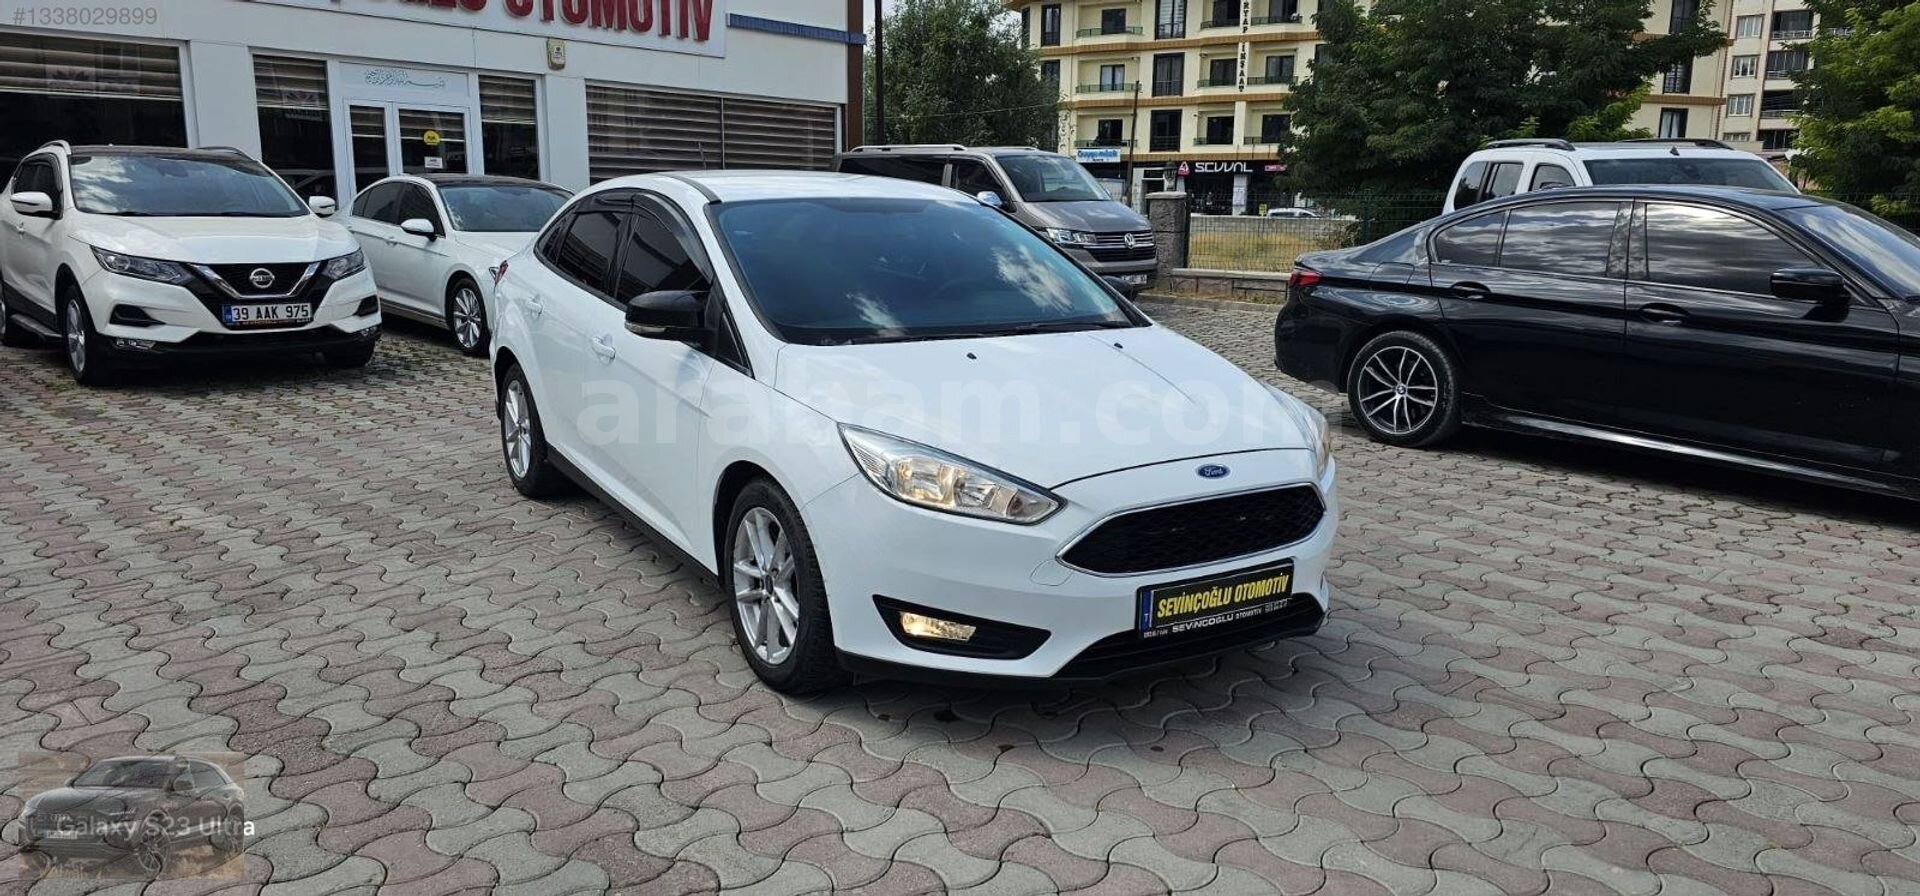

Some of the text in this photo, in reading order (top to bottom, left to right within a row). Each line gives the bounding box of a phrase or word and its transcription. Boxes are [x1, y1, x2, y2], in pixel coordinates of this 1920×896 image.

[232, 304, 309, 321] 39 AAK 975
[1203, 466, 1224, 477] Ford
[1157, 586, 1233, 618] SEVİNÇOĞLU
[1234, 572, 1289, 603] OTOMOTİV
